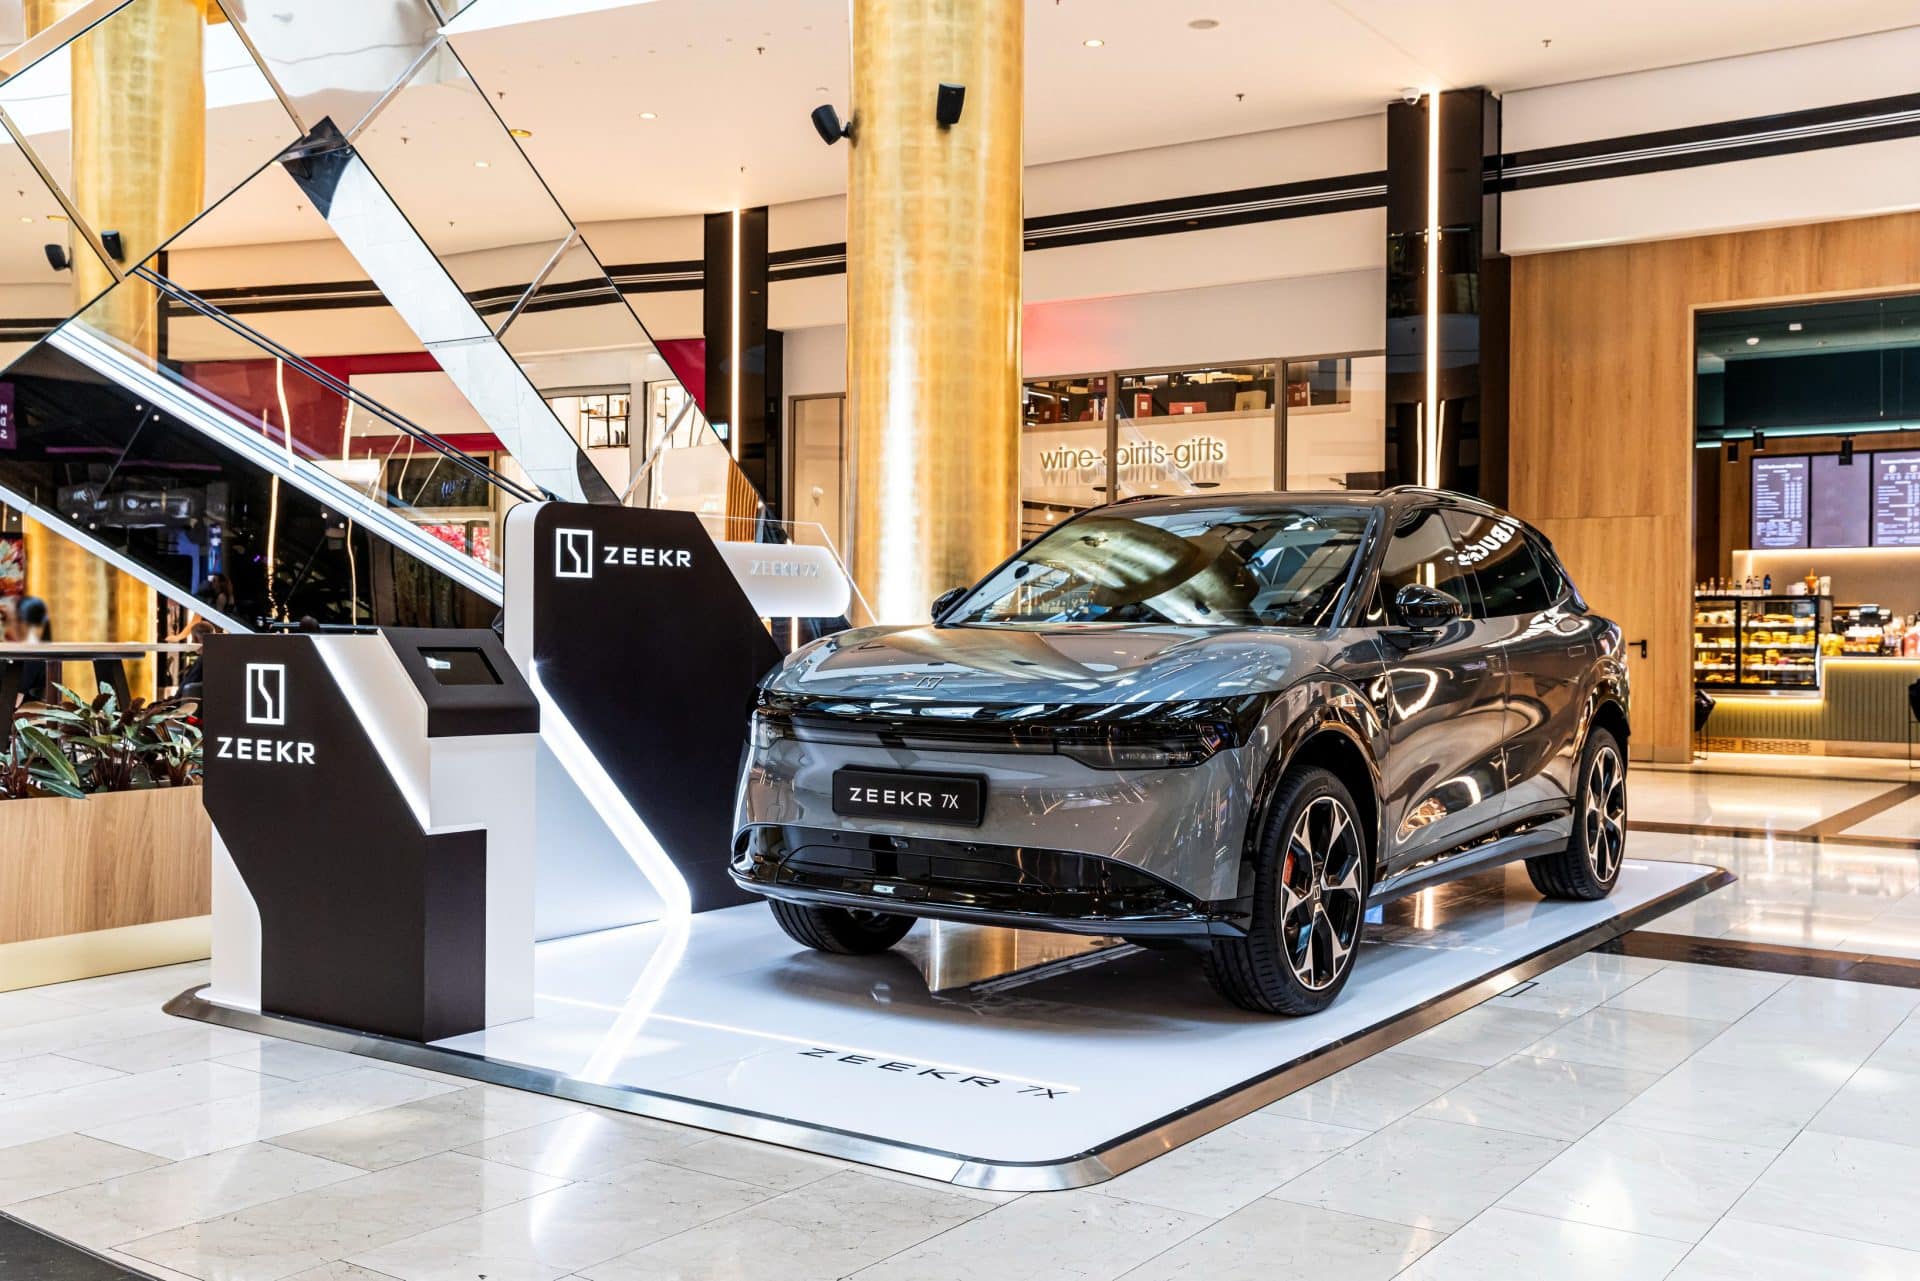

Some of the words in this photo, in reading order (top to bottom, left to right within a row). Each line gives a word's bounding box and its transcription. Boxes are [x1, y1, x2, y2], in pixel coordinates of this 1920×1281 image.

[603, 546, 692, 568] ZEEKR
[216, 736, 316, 765] ZEEKR
[849, 787, 932, 808] ZEEKR
[941, 793, 960, 809] 7X
[797, 1047, 1001, 1088] ZEEKR
[1016, 1084, 1070, 1101] 7X
